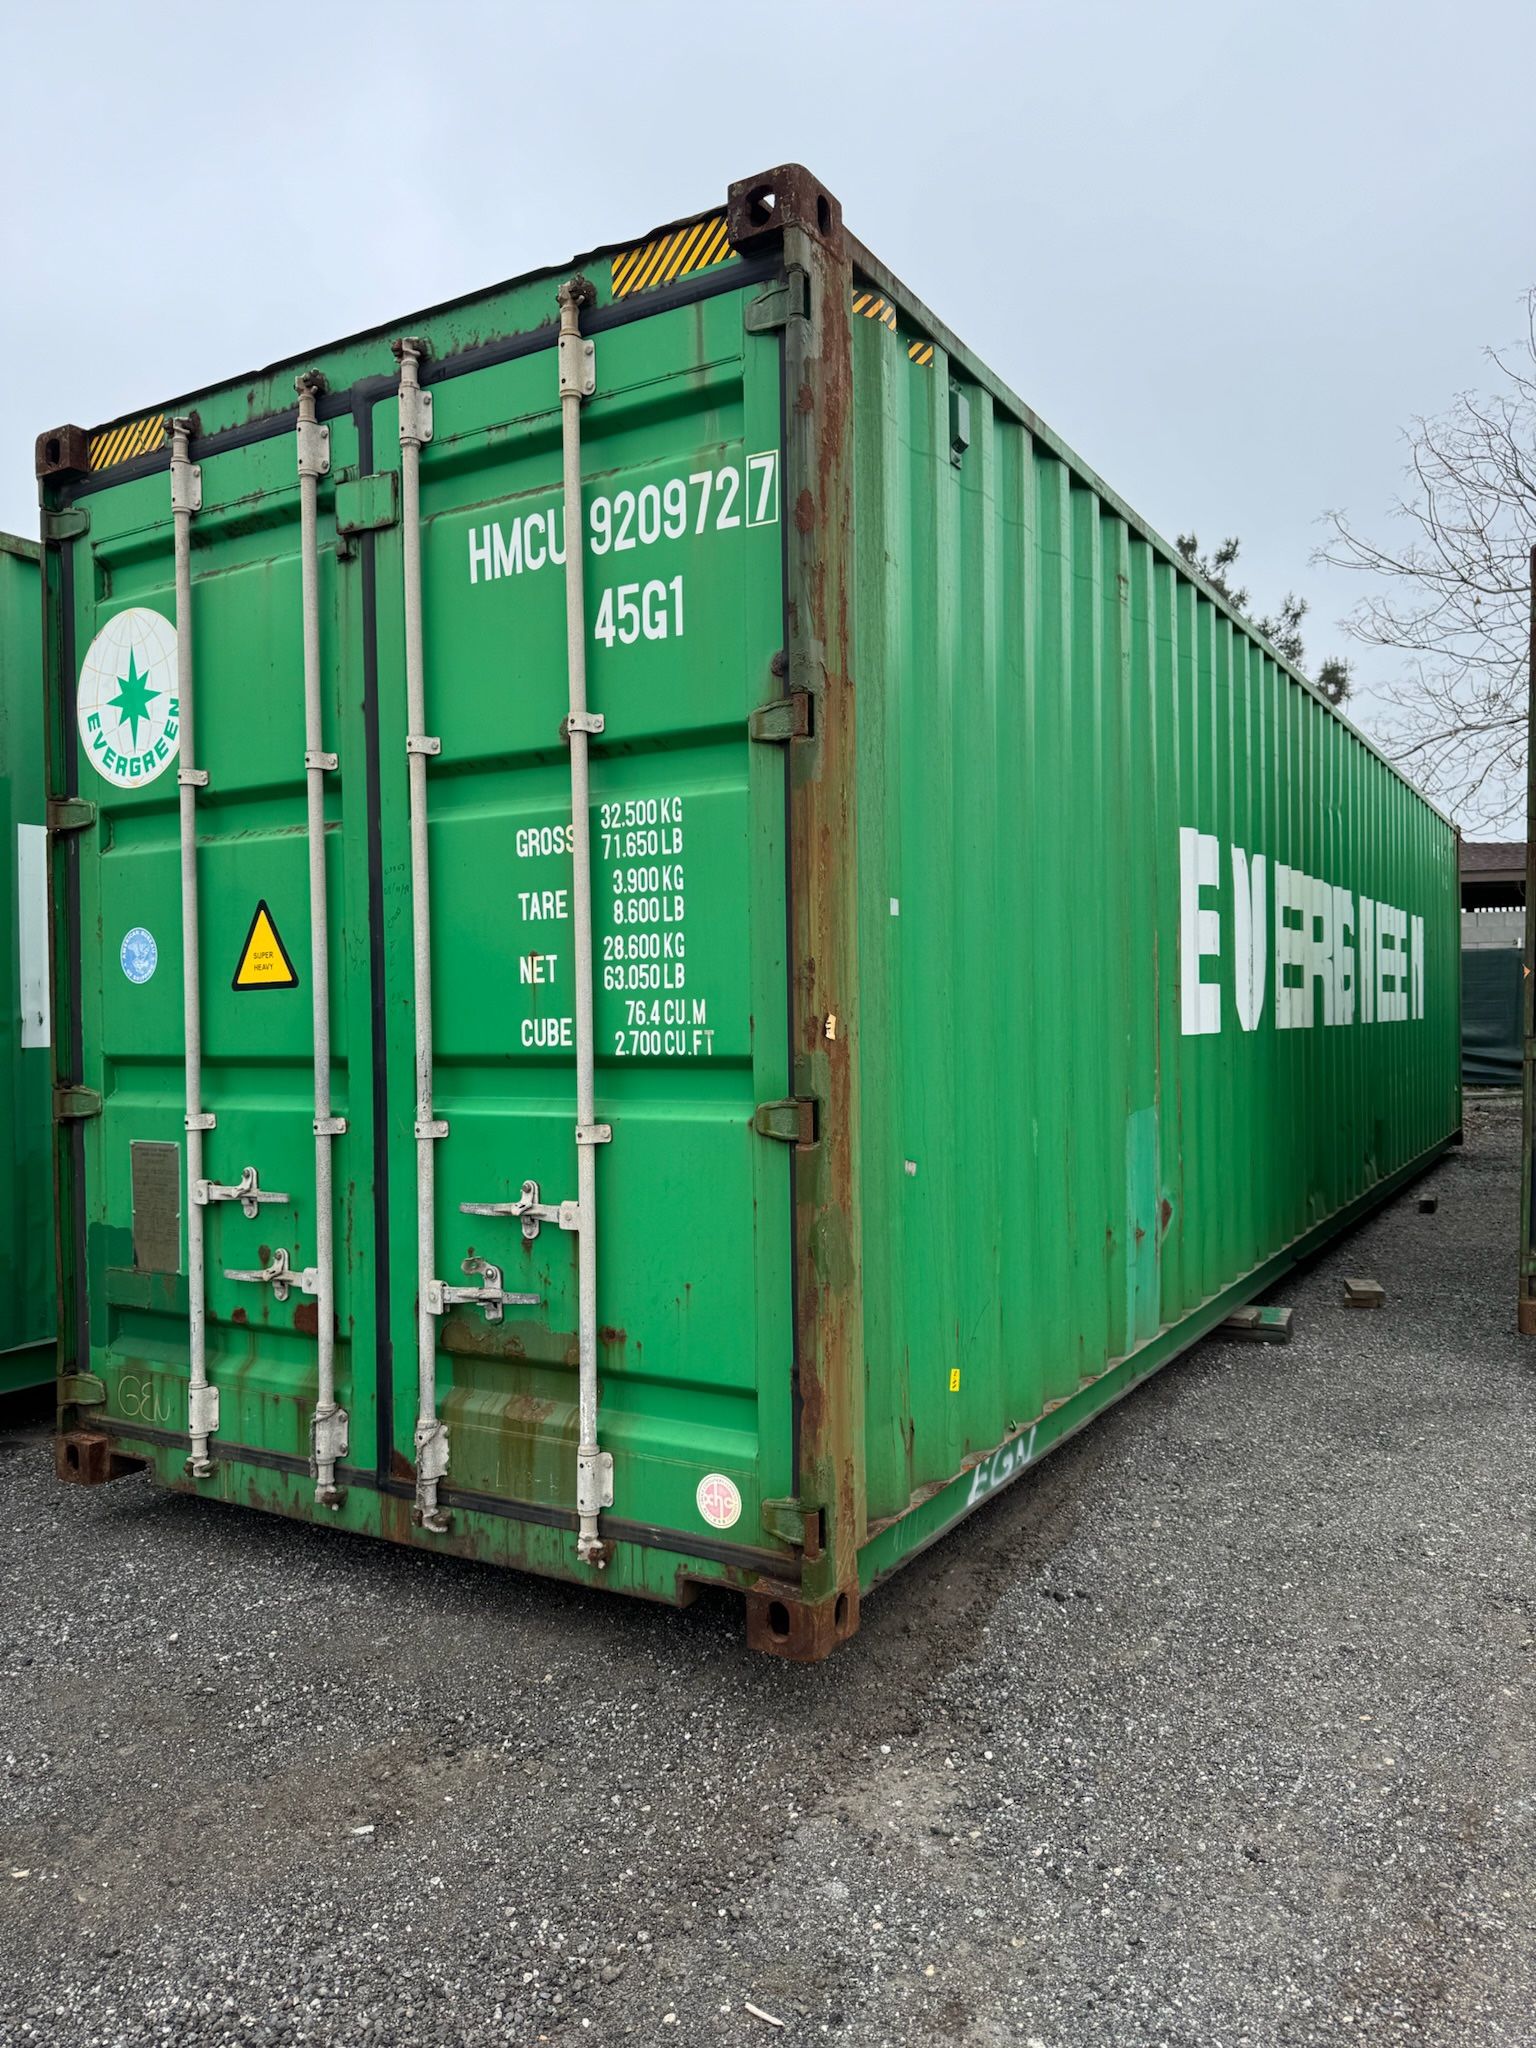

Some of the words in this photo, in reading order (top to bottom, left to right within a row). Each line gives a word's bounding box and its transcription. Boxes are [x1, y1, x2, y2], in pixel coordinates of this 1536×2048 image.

[468, 506, 567, 584] HMCU
[594, 575, 683, 648] 45G1
[87, 698, 179, 777] EVERGREEN
[600, 799, 657, 829] 32.500
[660, 797, 682, 823] KG
[516, 824, 574, 858] GROSS
[601, 829, 658, 859] 71.650
[661, 827, 683, 855] LB
[613, 866, 659, 894] 3.900
[662, 864, 684, 891] KG
[518, 890, 568, 921] TARE
[613, 898, 660, 925] 8.600
[663, 895, 684, 922] LB
[253, 951, 274, 960] SUPER
[603, 933, 660, 961] 28.600
[663, 932, 685, 958] KG
[254, 963, 274, 972] HEAVY
[519, 954, 557, 984] NET
[603, 963, 660, 991] 63.050
[663, 963, 685, 989] LB
[625, 1000, 660, 1026] 76.4
[521, 1018, 572, 1046] CUBE
[615, 1030, 661, 1056] 2.700
